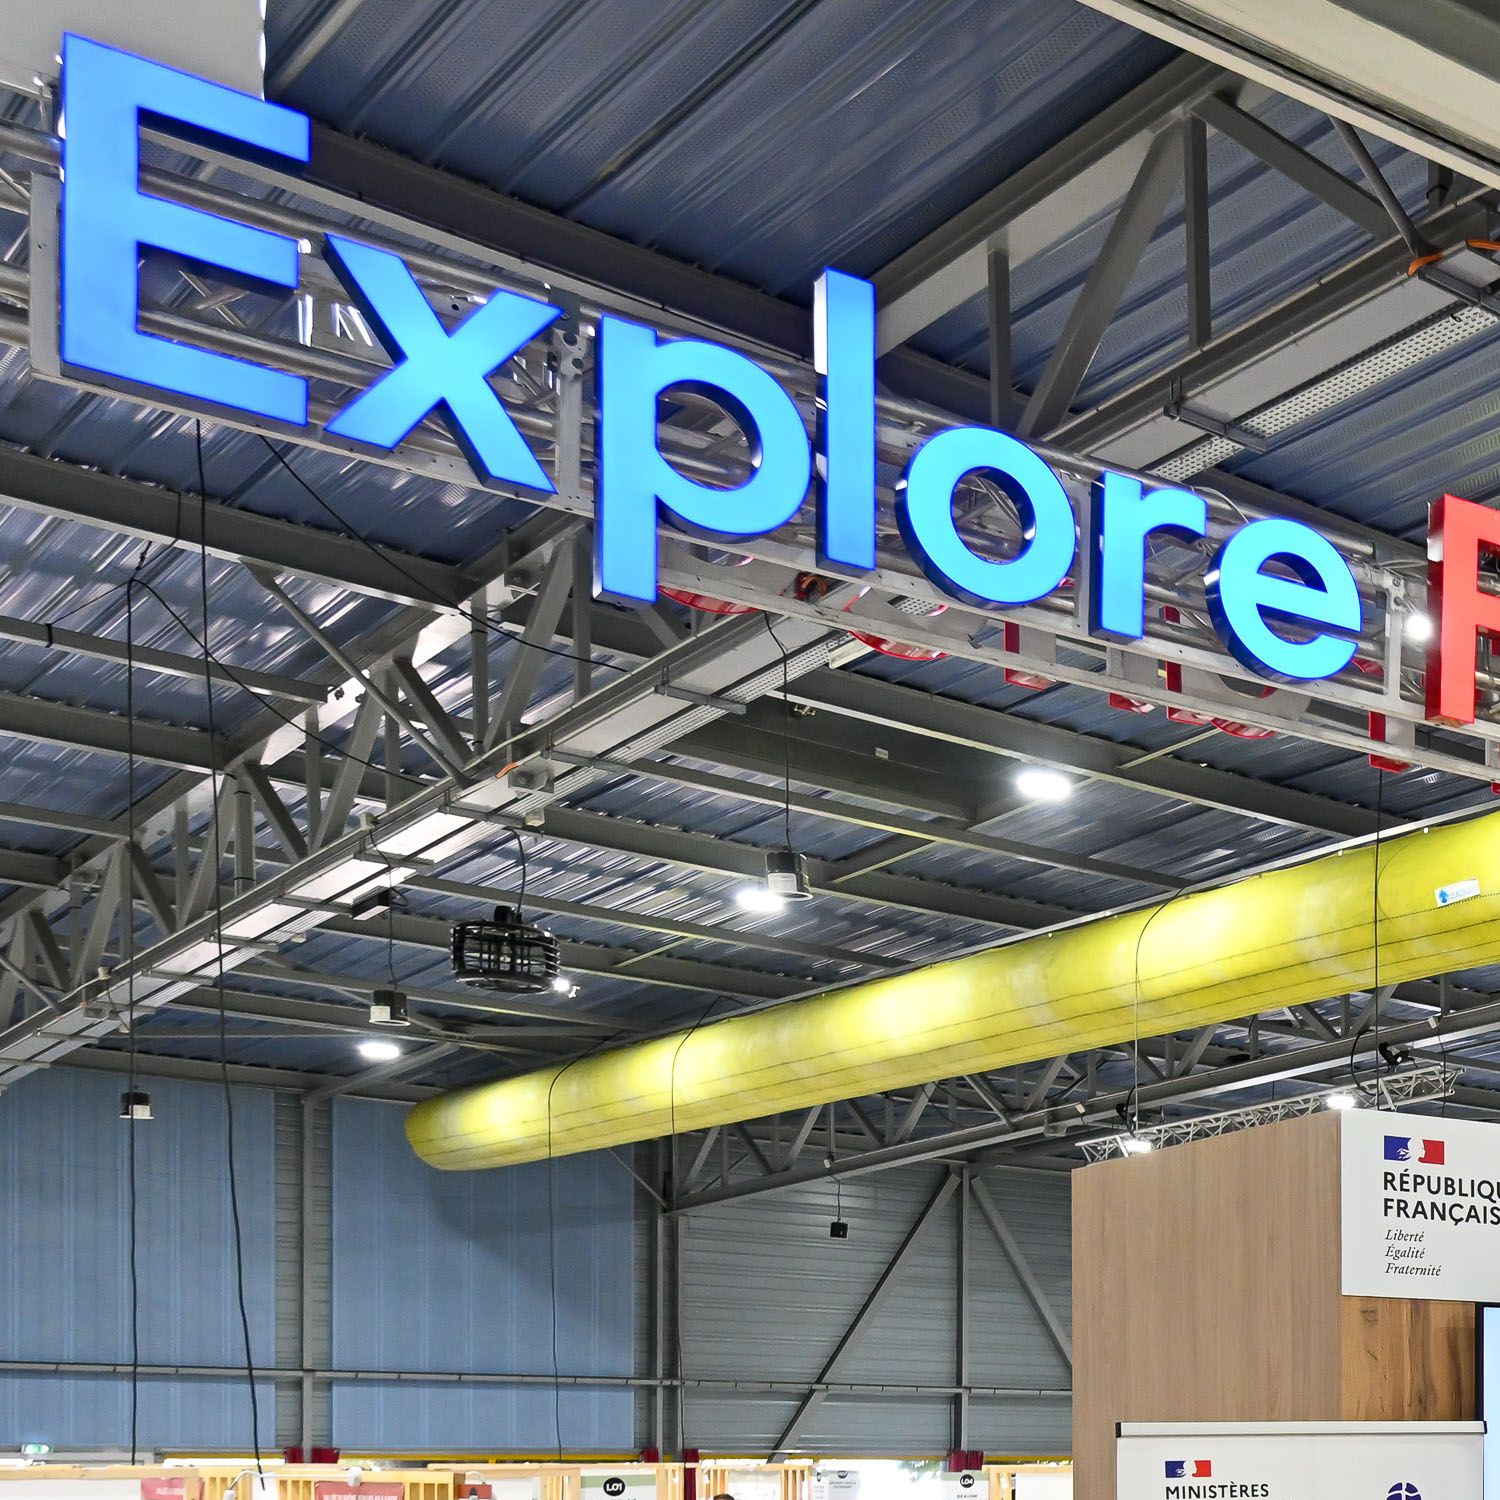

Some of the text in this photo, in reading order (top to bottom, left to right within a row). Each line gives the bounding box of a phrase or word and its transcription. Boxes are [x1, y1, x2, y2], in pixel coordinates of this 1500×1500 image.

[60, 31, 1363, 684] Explore
[1385, 1229, 1425, 1243] Liberté
[1385, 1245, 1426, 1261] Égalité
[1385, 1261, 1442, 1277] Fraternité
[1165, 1481, 1270, 1500] MINISTÈRES
